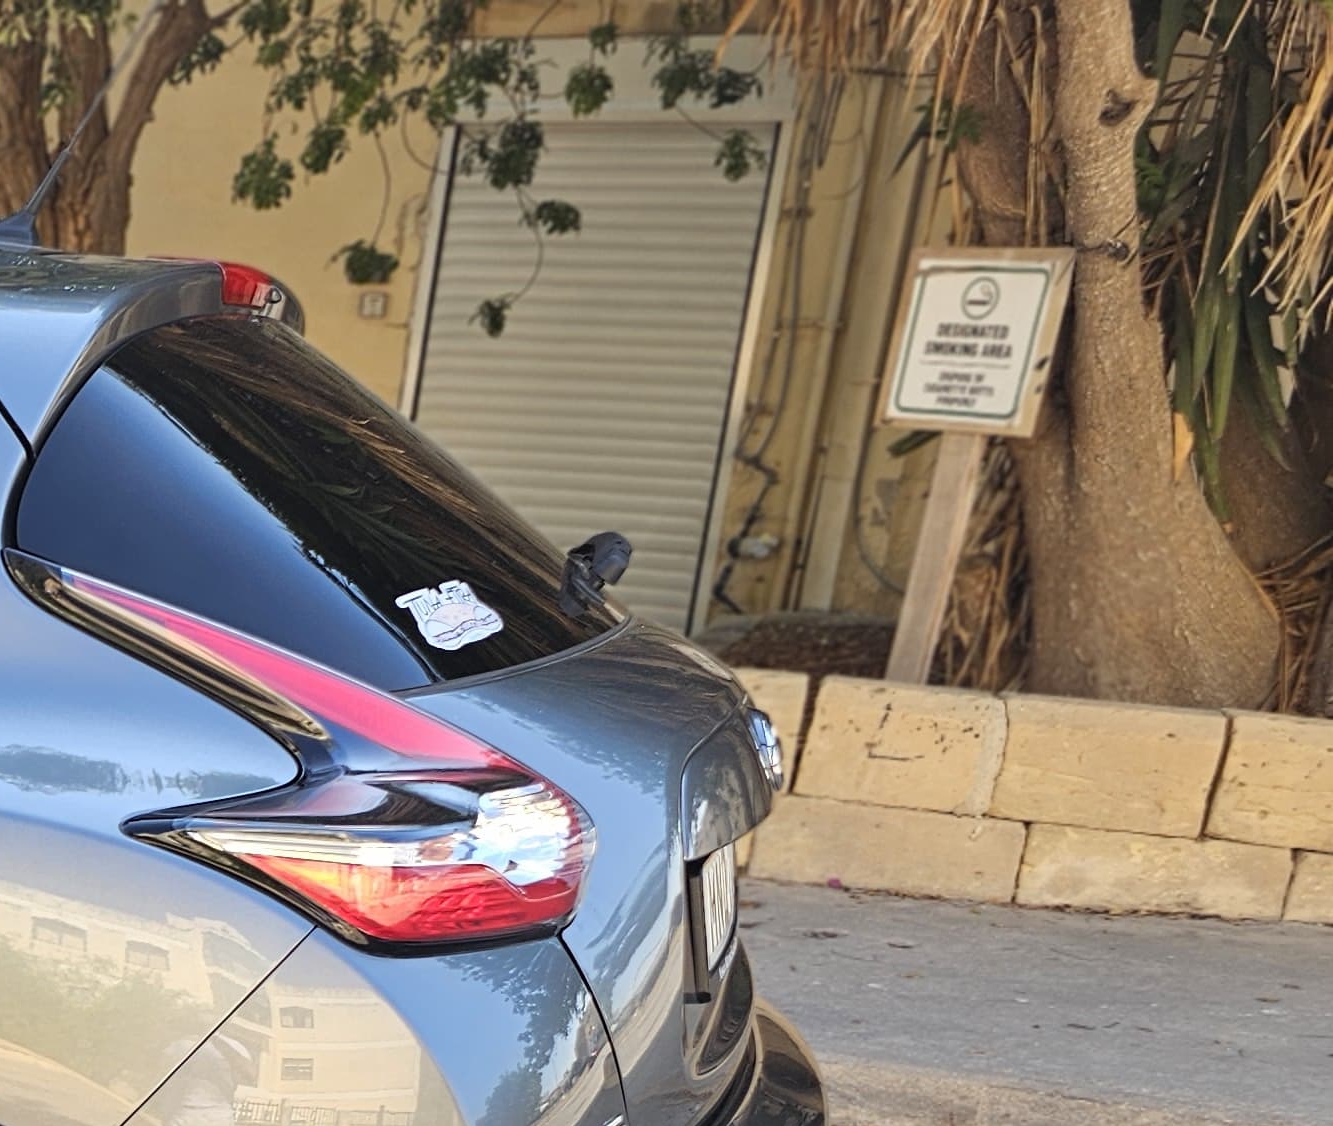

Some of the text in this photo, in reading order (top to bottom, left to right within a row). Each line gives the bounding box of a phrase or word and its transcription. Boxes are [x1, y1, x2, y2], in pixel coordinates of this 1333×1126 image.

[937, 323, 1009, 339] DESIGNATED
[925, 342, 1012, 358] SMOKING AREA
